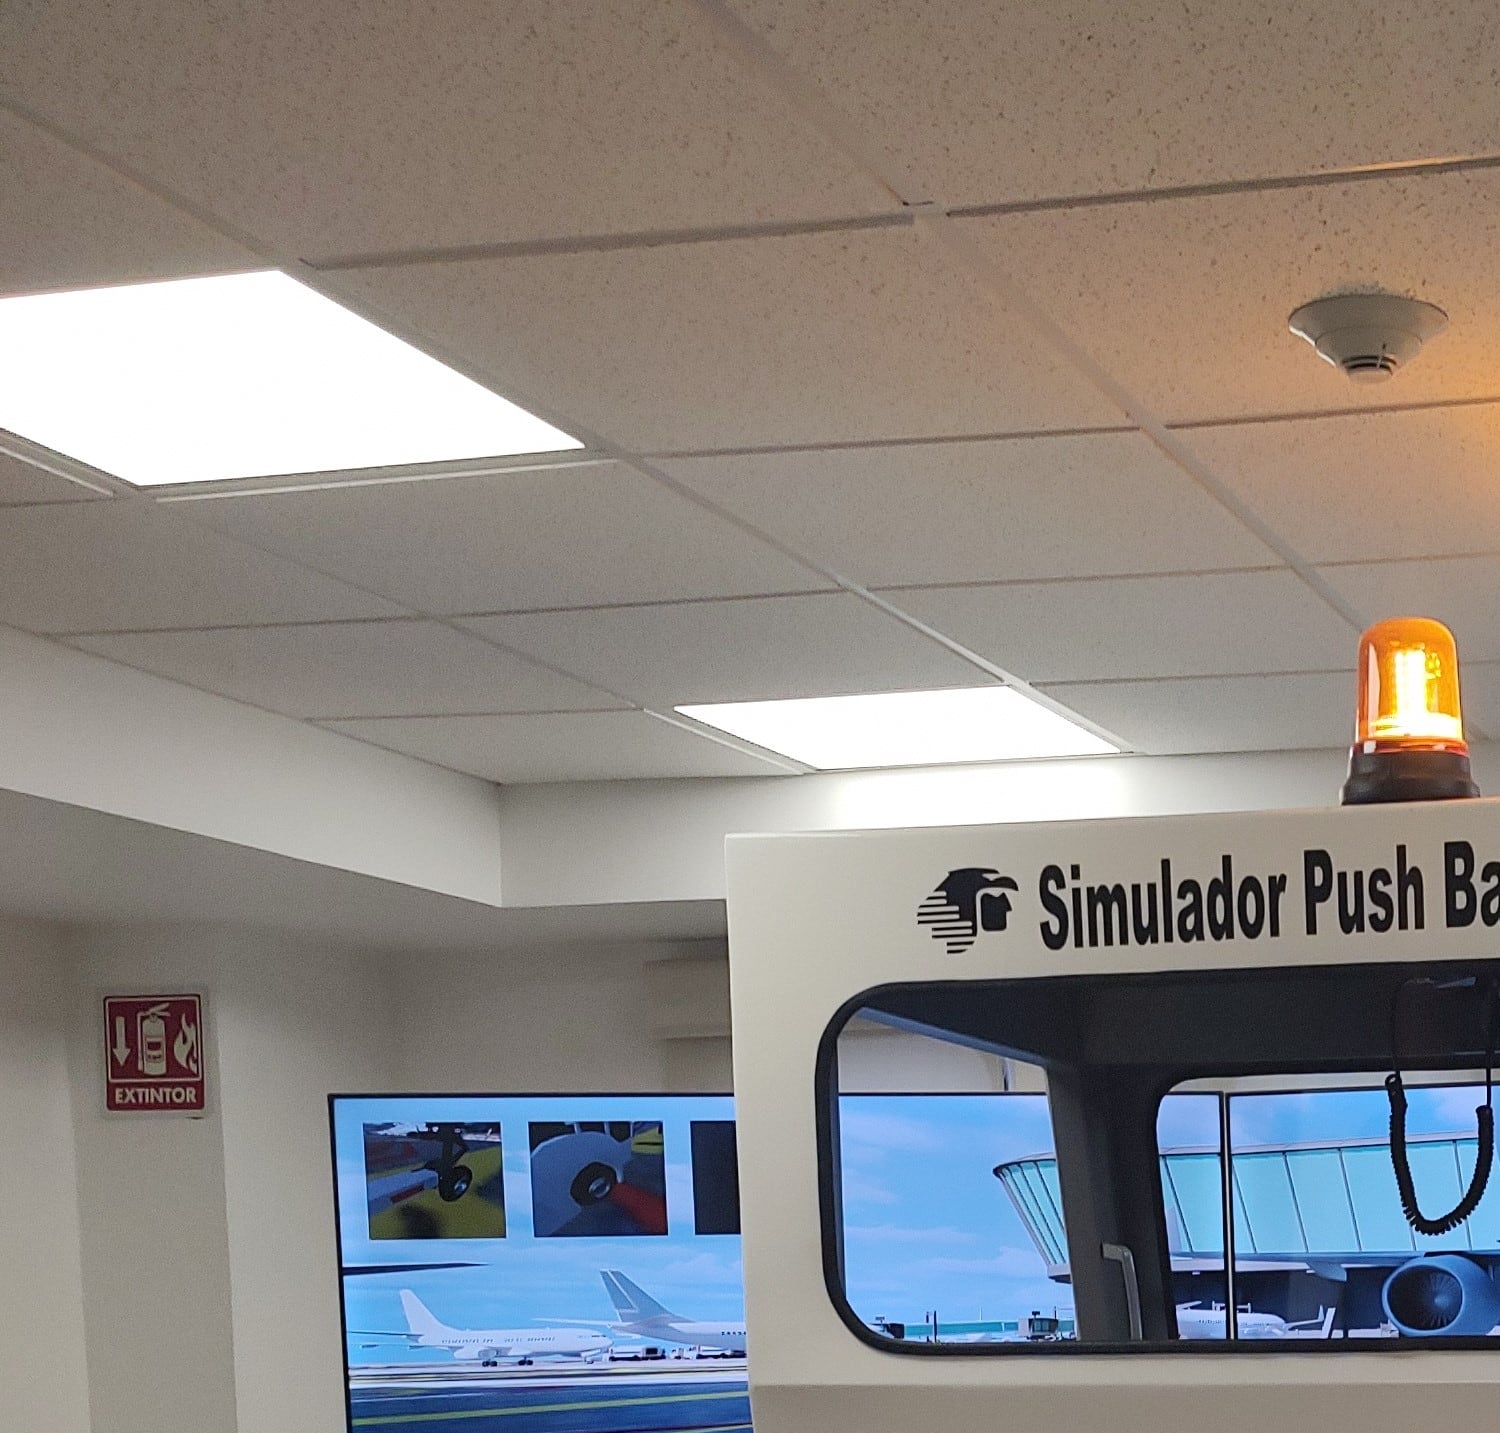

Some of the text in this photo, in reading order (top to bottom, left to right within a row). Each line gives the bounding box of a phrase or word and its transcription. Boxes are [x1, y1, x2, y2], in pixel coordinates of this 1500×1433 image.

[1039, 855, 1288, 951] Simulador
[1303, 844, 1425, 935] Push
[115, 1086, 197, 1105] EXTINTOR
